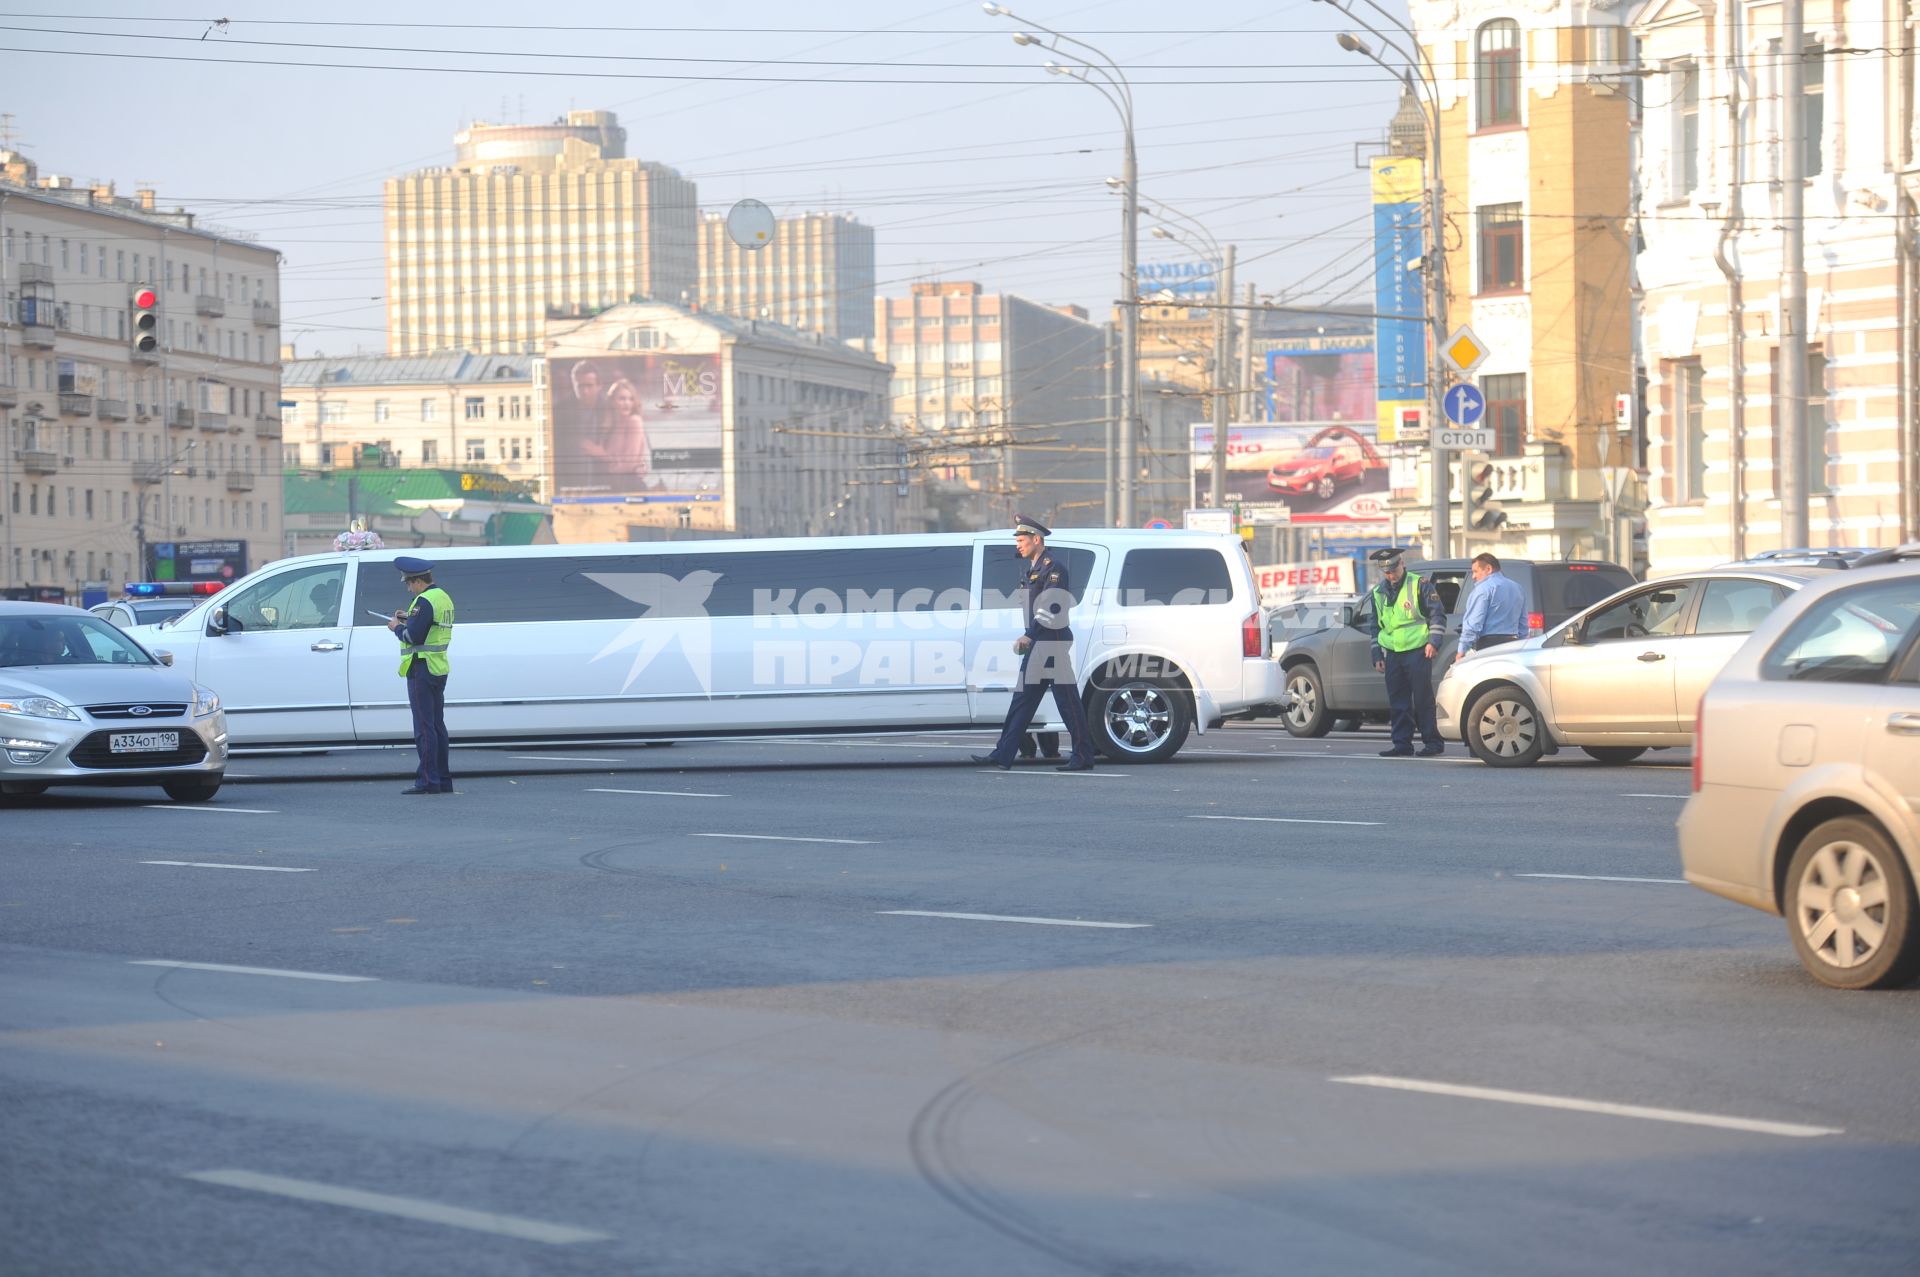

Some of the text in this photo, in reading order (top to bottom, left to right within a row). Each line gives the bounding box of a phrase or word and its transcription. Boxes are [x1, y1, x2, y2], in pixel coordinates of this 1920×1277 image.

[663, 371, 718, 396] M&S
[1441, 432, 1487, 446] СТОП
[1356, 503, 1377, 512] KIA
[113, 733, 176, 748] А334ОТ 190
